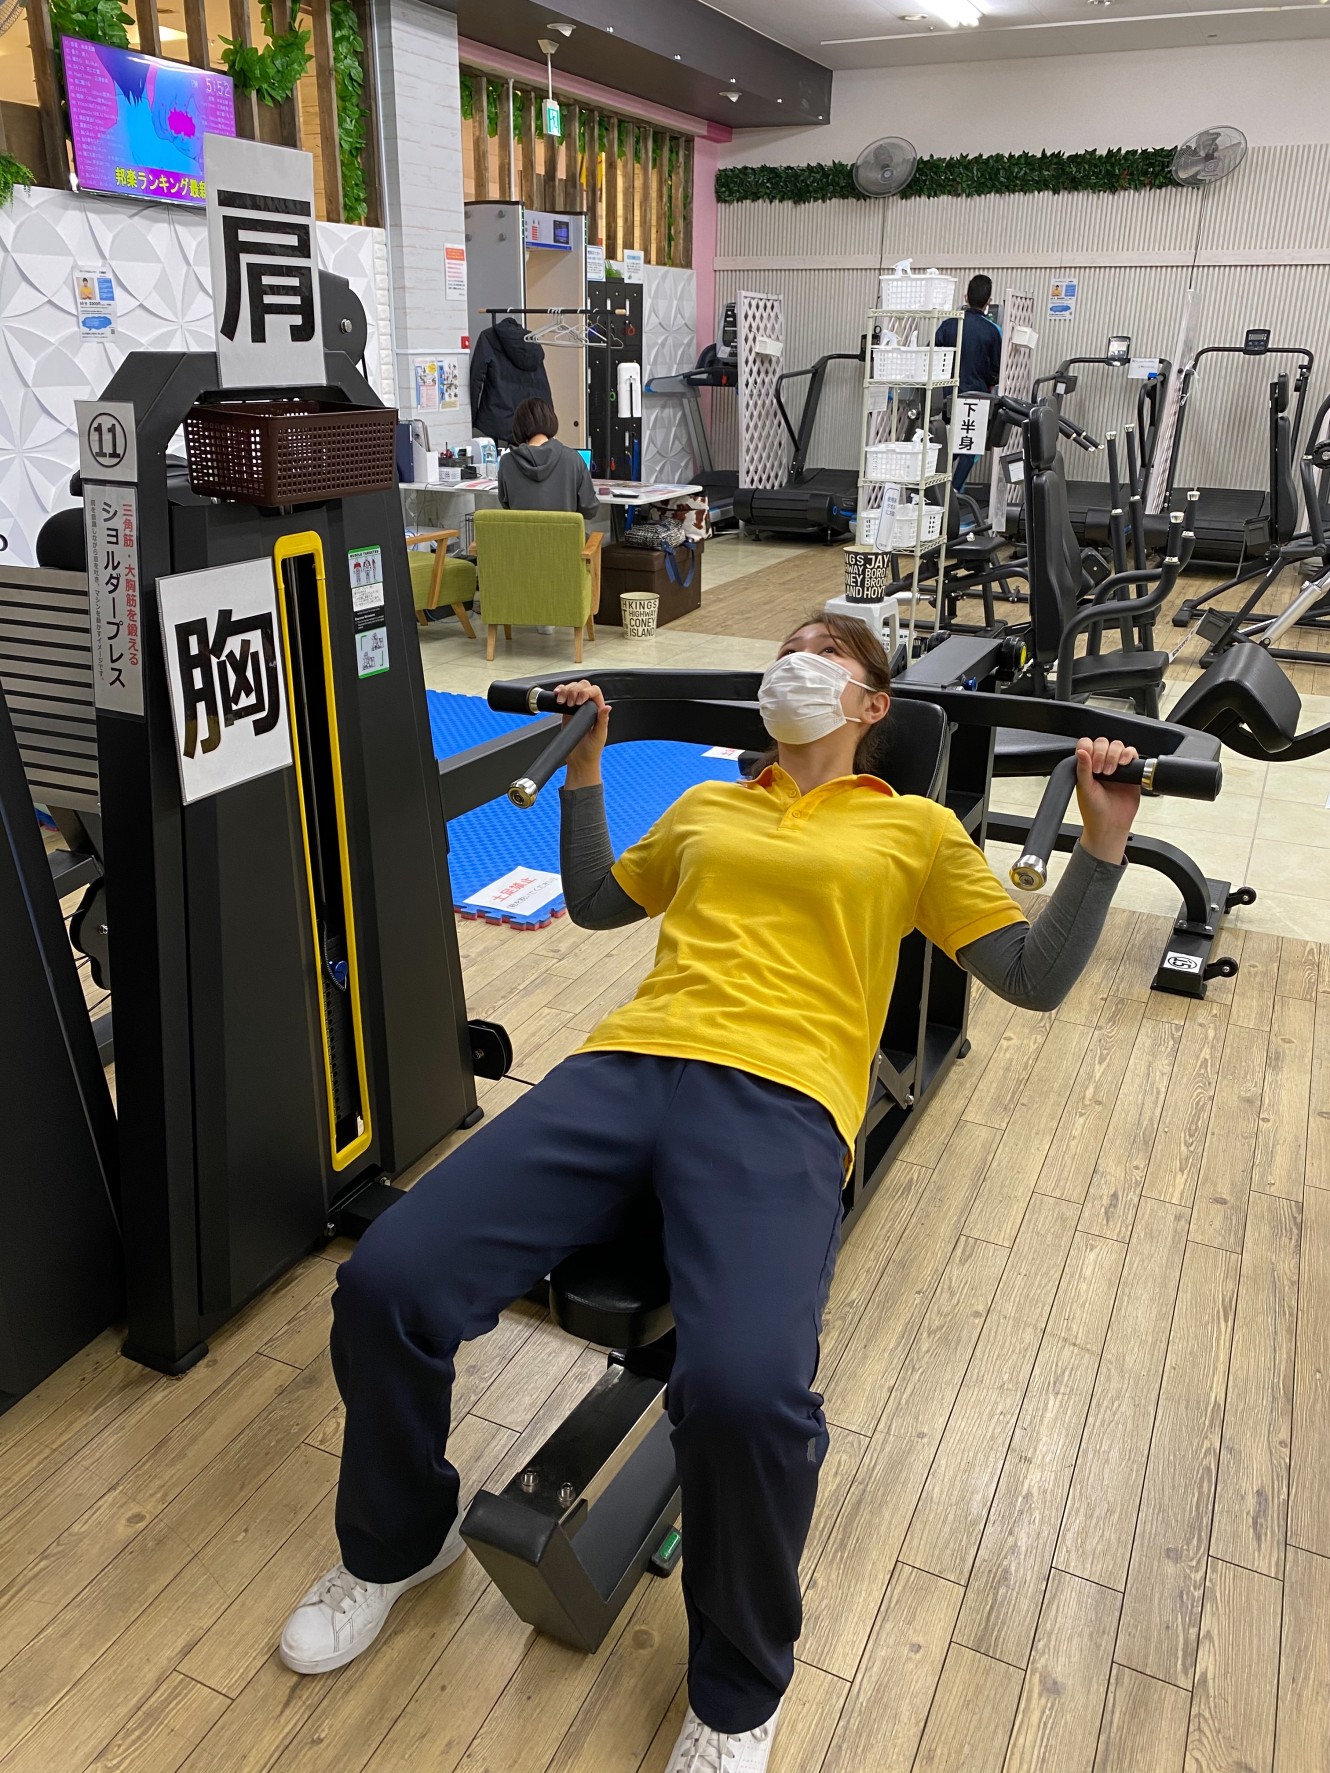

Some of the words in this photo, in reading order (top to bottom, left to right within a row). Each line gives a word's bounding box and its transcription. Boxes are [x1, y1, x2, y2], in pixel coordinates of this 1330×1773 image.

[205, 78, 230, 97] 5:52
[216, 188, 316, 344] 肩
[958, 402, 979, 451] 下半身
[866, 554, 890, 568] JAY
[122, 503, 139, 666] 三角筋・大胸筋を鍛える
[101, 501, 126, 688] ショルダープレス
[628, 600, 657, 610] KINGS
[628, 610, 656, 618] HIGHWAY
[629, 618, 656, 628] CONEY
[630, 627, 654, 637] ISLAND
[174, 608, 281, 760] 胸
